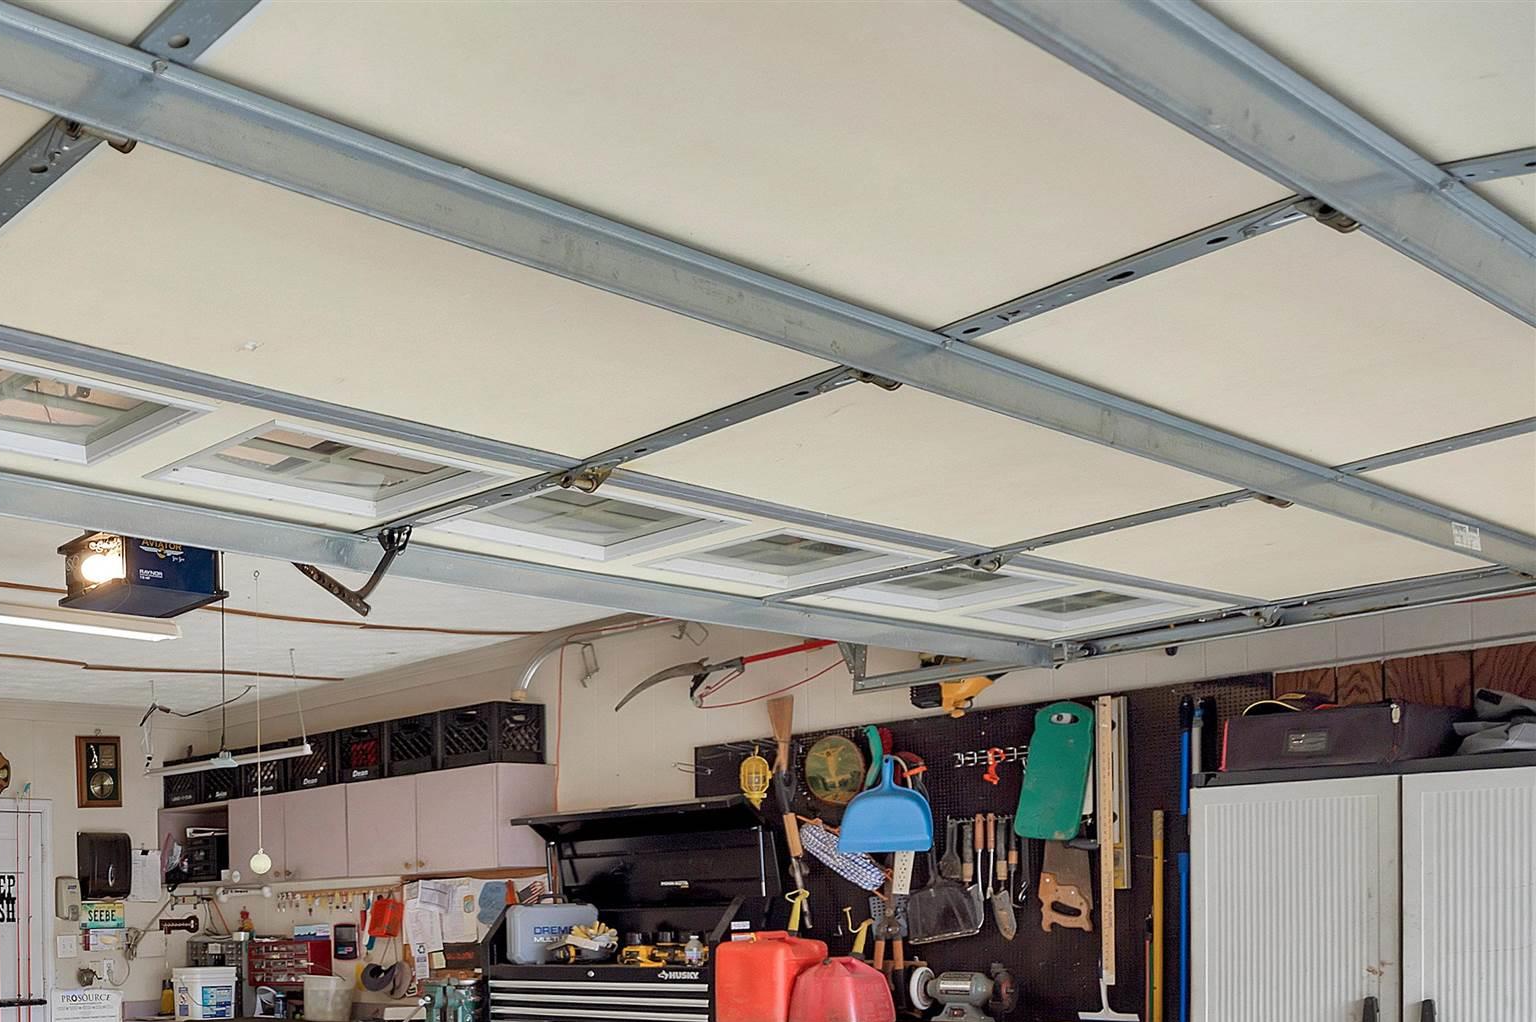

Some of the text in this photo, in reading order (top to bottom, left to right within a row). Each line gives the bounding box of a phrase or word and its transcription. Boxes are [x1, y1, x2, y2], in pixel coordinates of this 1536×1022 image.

[141, 540, 182, 550] AVIATOR
[88, 910, 116, 921] SEEBE
[534, 926, 573, 935] DREME
[668, 971, 699, 979] HUSKY
[61, 994, 112, 1003] PROSOURCE
